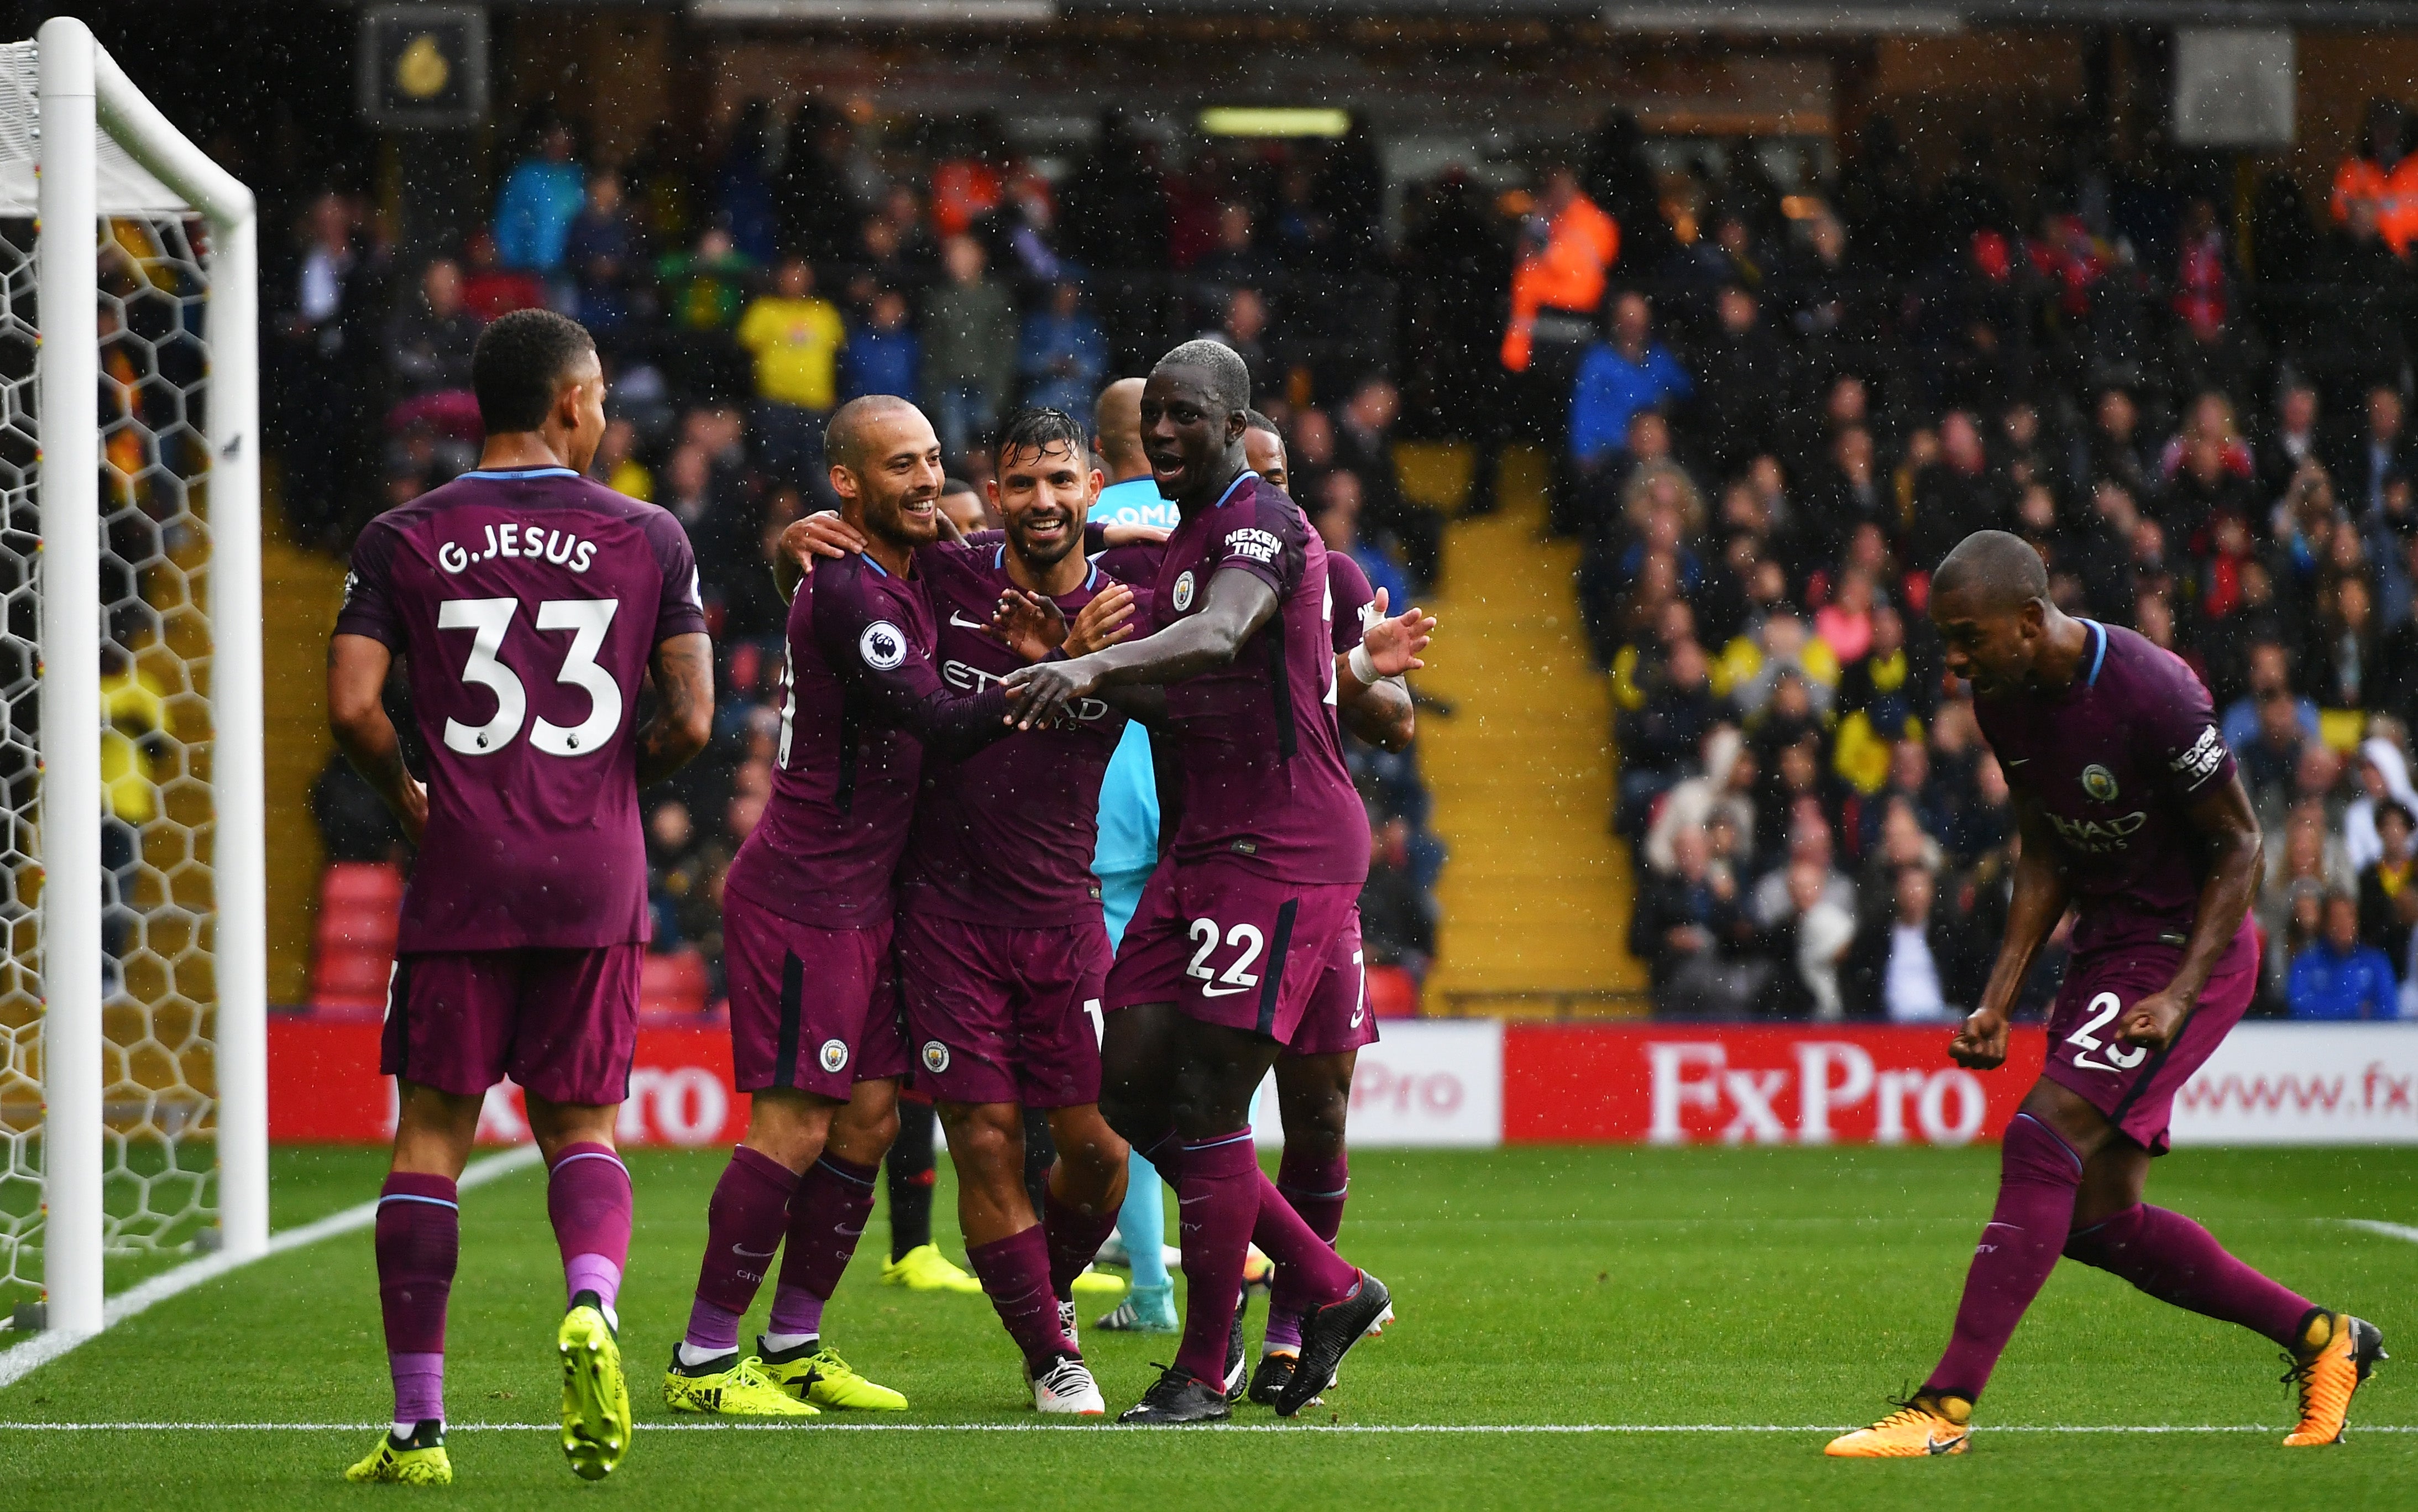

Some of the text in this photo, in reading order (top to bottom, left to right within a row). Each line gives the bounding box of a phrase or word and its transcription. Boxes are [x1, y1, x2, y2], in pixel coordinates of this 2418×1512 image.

[1096, 504, 1181, 525] GOME
[438, 524, 597, 574] G.JESUS
[1224, 528, 1283, 554] NEXEN
[1232, 542, 1274, 563] TIRE
[437, 597, 623, 757] 33
[2169, 724, 2217, 771] NEXEN
[2188, 745, 2223, 778] TIRE
[1186, 918, 1264, 987] 22
[1349, 1060, 1466, 1115] Pro
[1648, 1040, 1986, 1144] FxPro
[2180, 1060, 2417, 1114] www.fx
[736, 1269, 763, 1283] CITY
